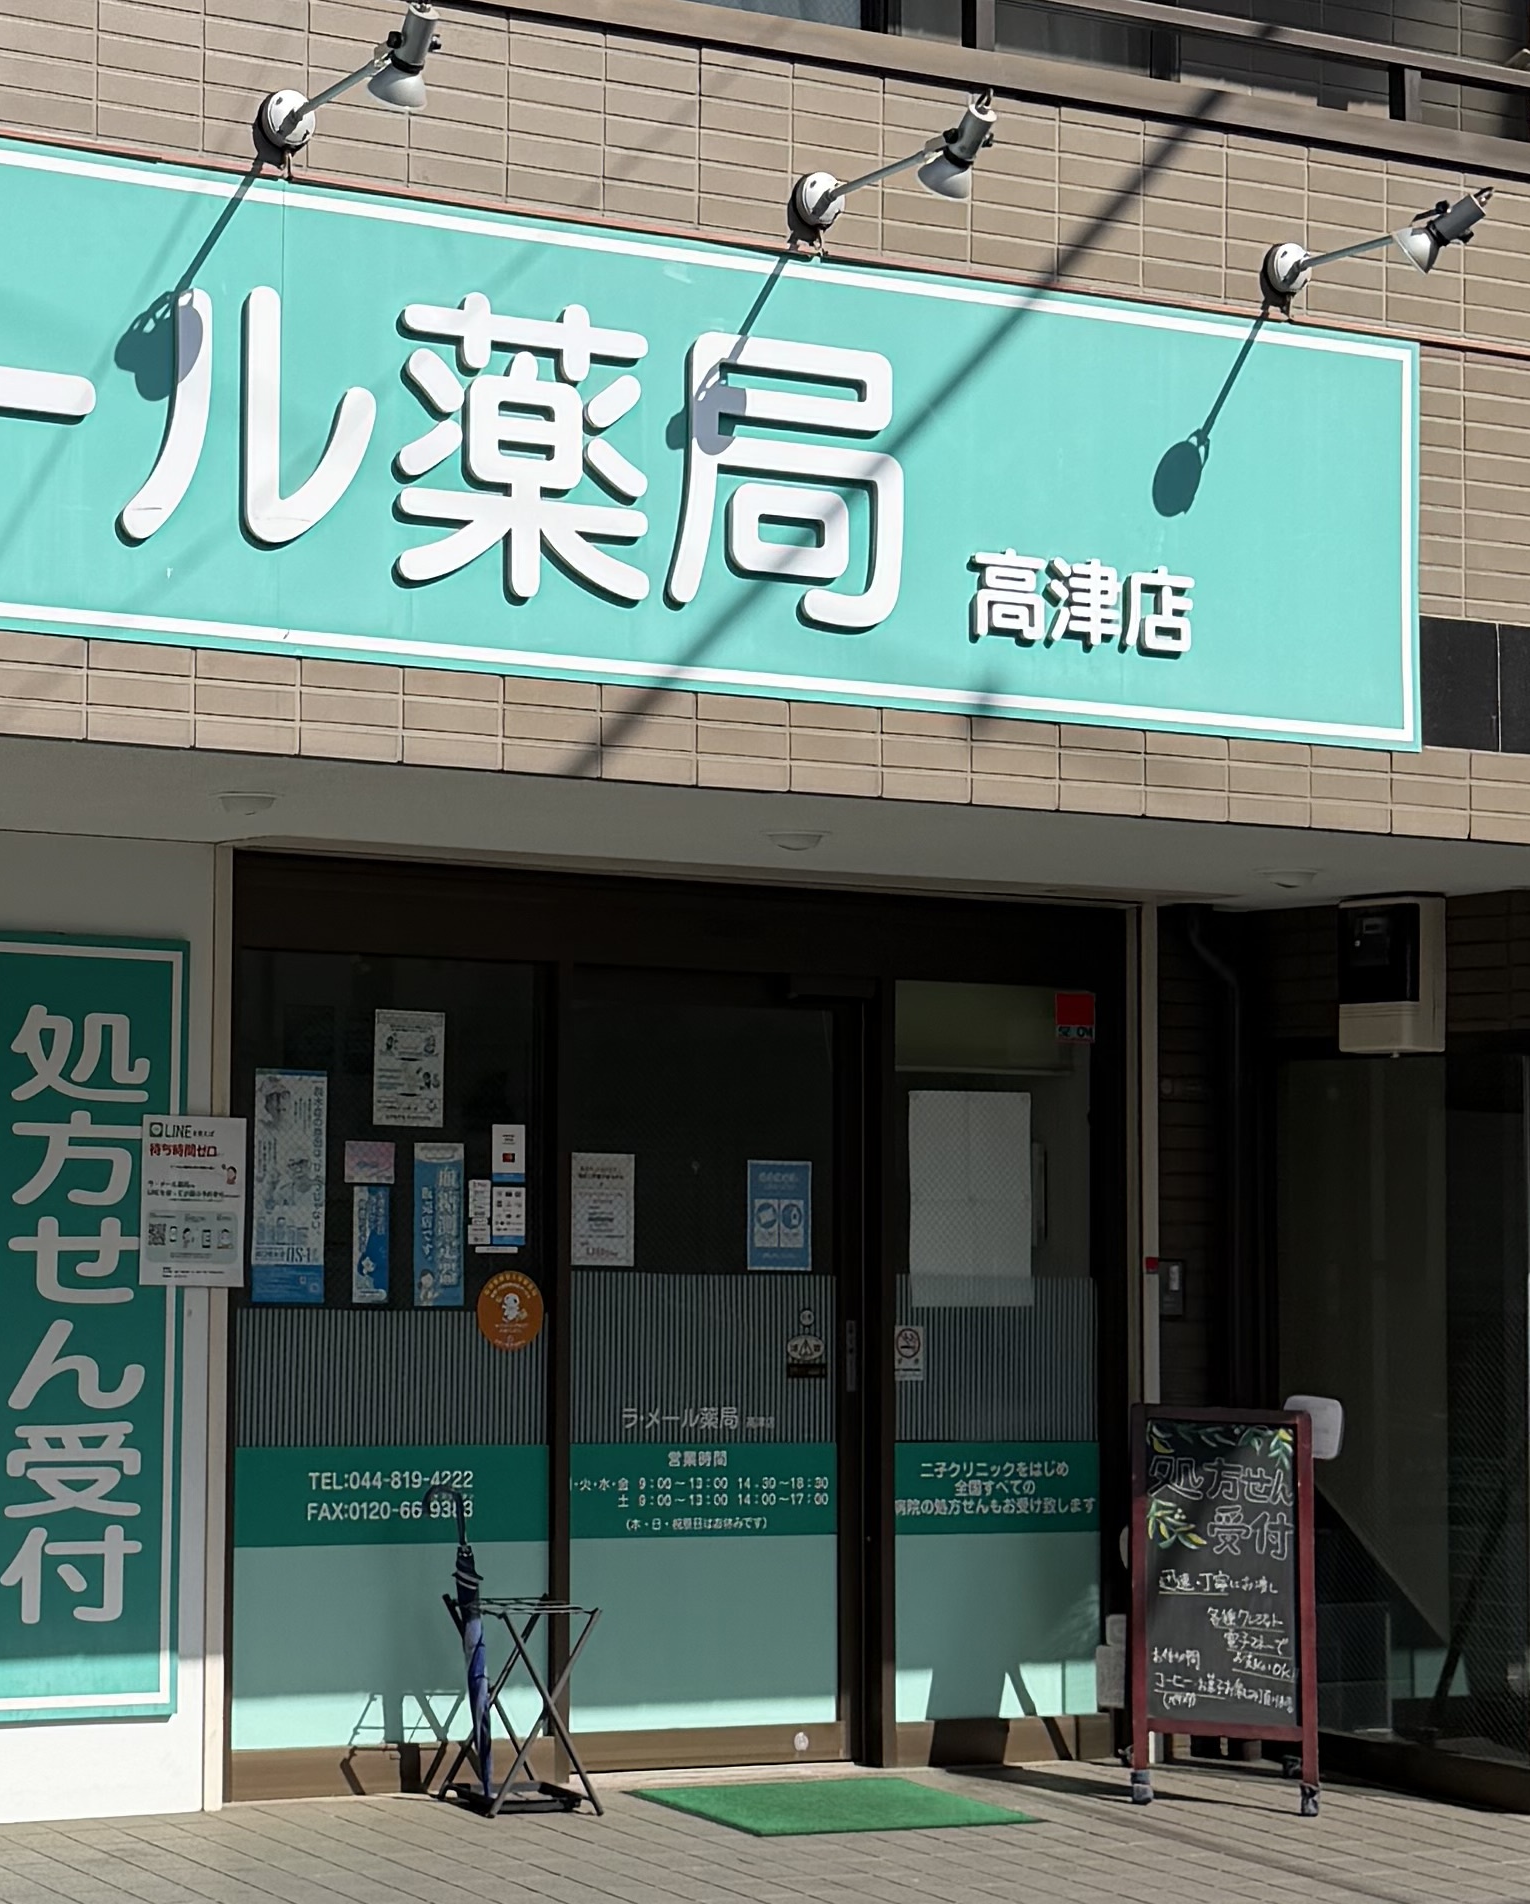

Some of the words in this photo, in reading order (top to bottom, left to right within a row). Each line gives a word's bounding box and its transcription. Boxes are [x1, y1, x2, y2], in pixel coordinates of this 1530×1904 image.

[973, 548, 1196, 655] 高津店
[0, 1003, 150, 1625] 処方せん受付
[668, 1451, 728, 1467] 営業時間
[308, 1471, 474, 1490] TEL:044-819-4222
[569, 1477, 629, 1491] ・火・水・金
[954, 1479, 1036, 1496] 全国すべての
[1147, 1455, 1294, 1506] 処方せん
[307, 1500, 474, 1521] FAX:0120-66933
[618, 1496, 629, 1507] 土
[1207, 1505, 1295, 1561] 受付
